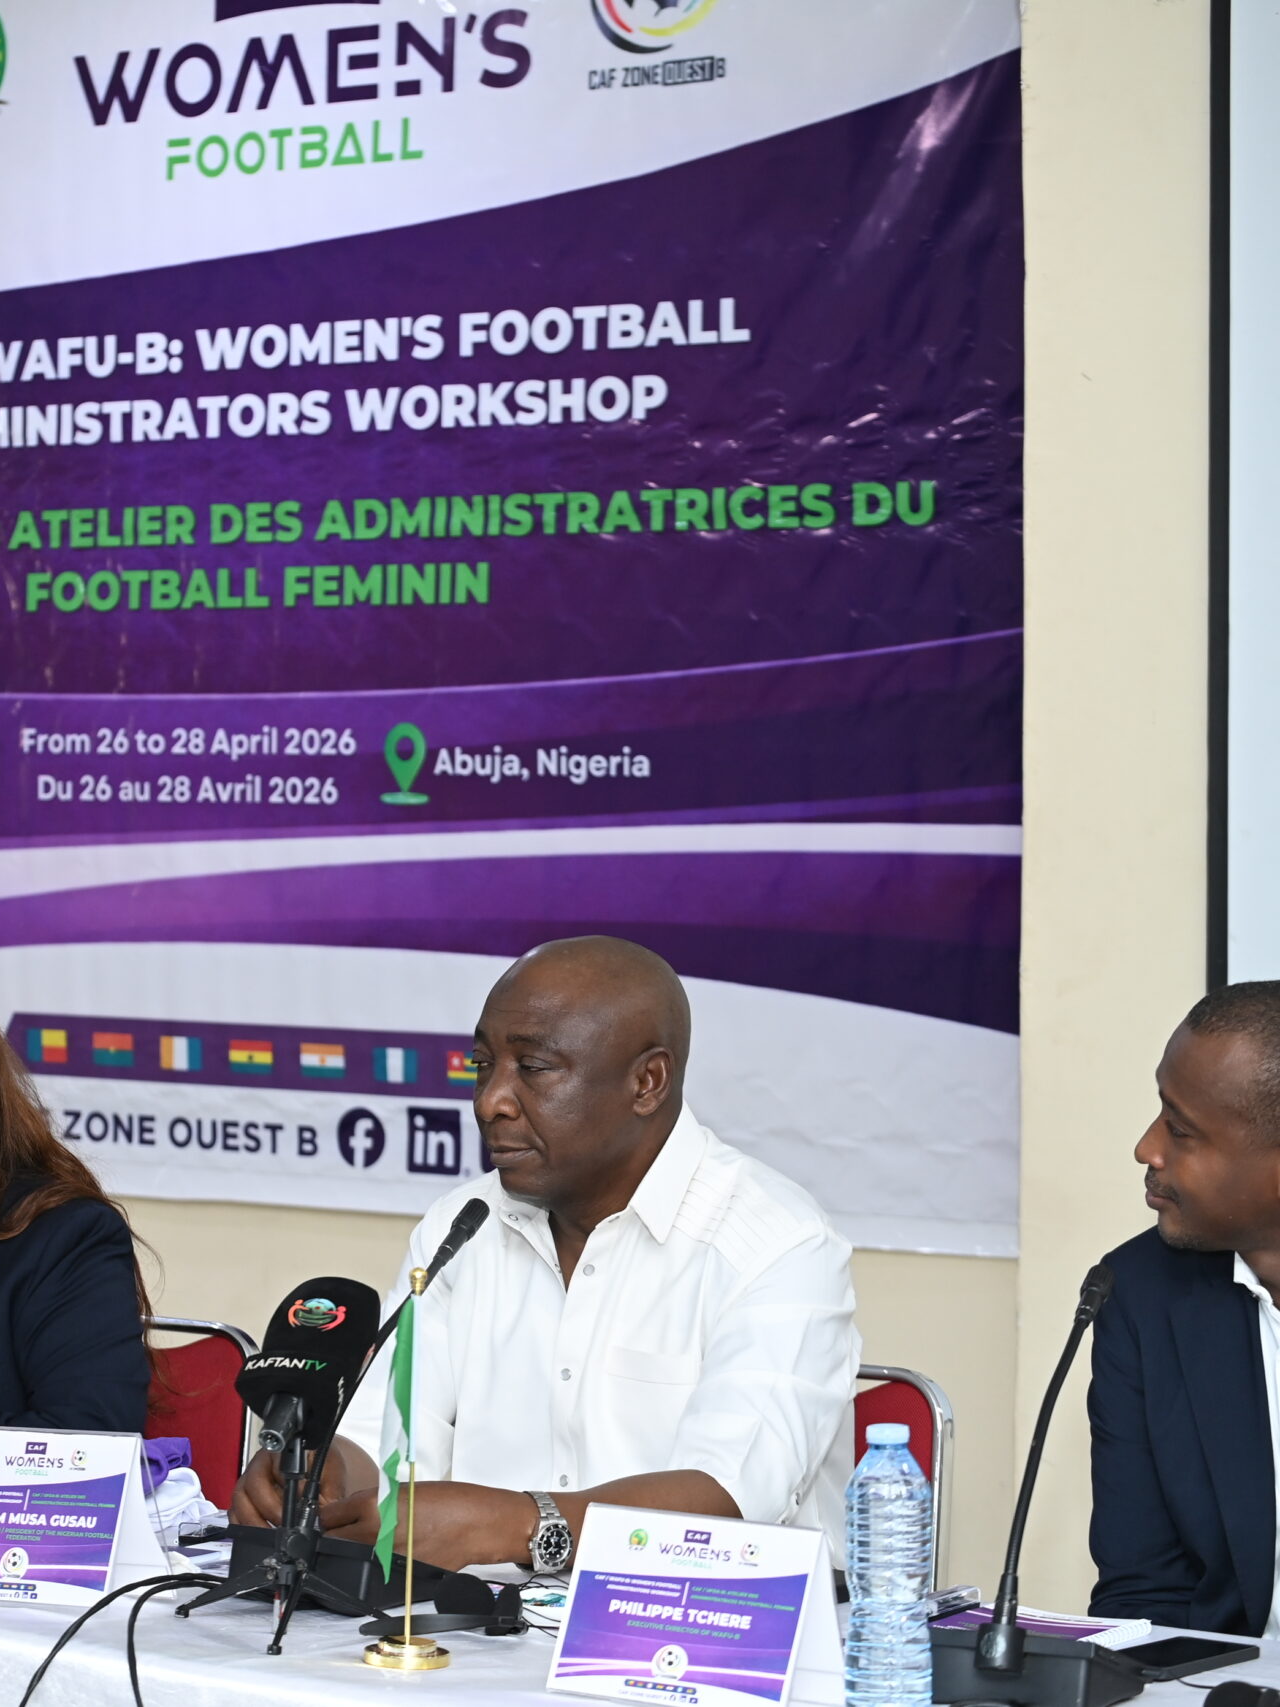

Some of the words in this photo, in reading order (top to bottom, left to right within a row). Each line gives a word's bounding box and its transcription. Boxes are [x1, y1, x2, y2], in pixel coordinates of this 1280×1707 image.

[73, 9, 532, 126] WOMEN'S
[588, 69, 616, 90] CAF
[621, 65, 662, 88] ZONE
[663, 57, 714, 85] OUEST
[715, 57, 726, 79] B
[166, 116, 423, 181] FOOTBALL
[196, 314, 444, 371] WOMEN'S
[459, 296, 751, 358] FOOTBALL
[344, 374, 668, 433] WORKSHOP
[8, 506, 195, 550] ATELIER
[210, 501, 302, 544] DES
[314, 483, 835, 541] ADMINISTRATRICES
[851, 480, 934, 527] DU
[26, 568, 269, 612] FOOTBALL
[284, 562, 489, 606] FEMININ
[21, 728, 90, 755] From
[97, 728, 129, 755] 26
[135, 729, 164, 755] to
[172, 728, 206, 755] 28
[211, 726, 278, 759] April
[284, 728, 356, 756] 2026
[433, 747, 529, 782] Abuja,
[537, 748, 650, 785] Nigeria
[37, 776, 73, 802] Du
[80, 776, 112, 802] 26
[119, 782, 151, 802] au
[157, 776, 191, 802] 28
[198, 775, 263, 803] Avril
[268, 777, 338, 804] 2026
[63, 1110, 156, 1146] ZONE
[168, 1117, 283, 1154] OUEST
[297, 1125, 319, 1157] B
[244, 1356, 327, 1371] KAFTANTV
[5, 1455, 64, 1469] WOMEN'S
[8, 1512, 47, 1526] MUSA
[50, 1514, 97, 1528] GUSAU
[687, 1532, 709, 1541] CAF
[659, 1543, 731, 1562] WOMEN'S
[609, 1599, 685, 1621] PHILIPPE
[687, 1608, 752, 1630] TCHERE
